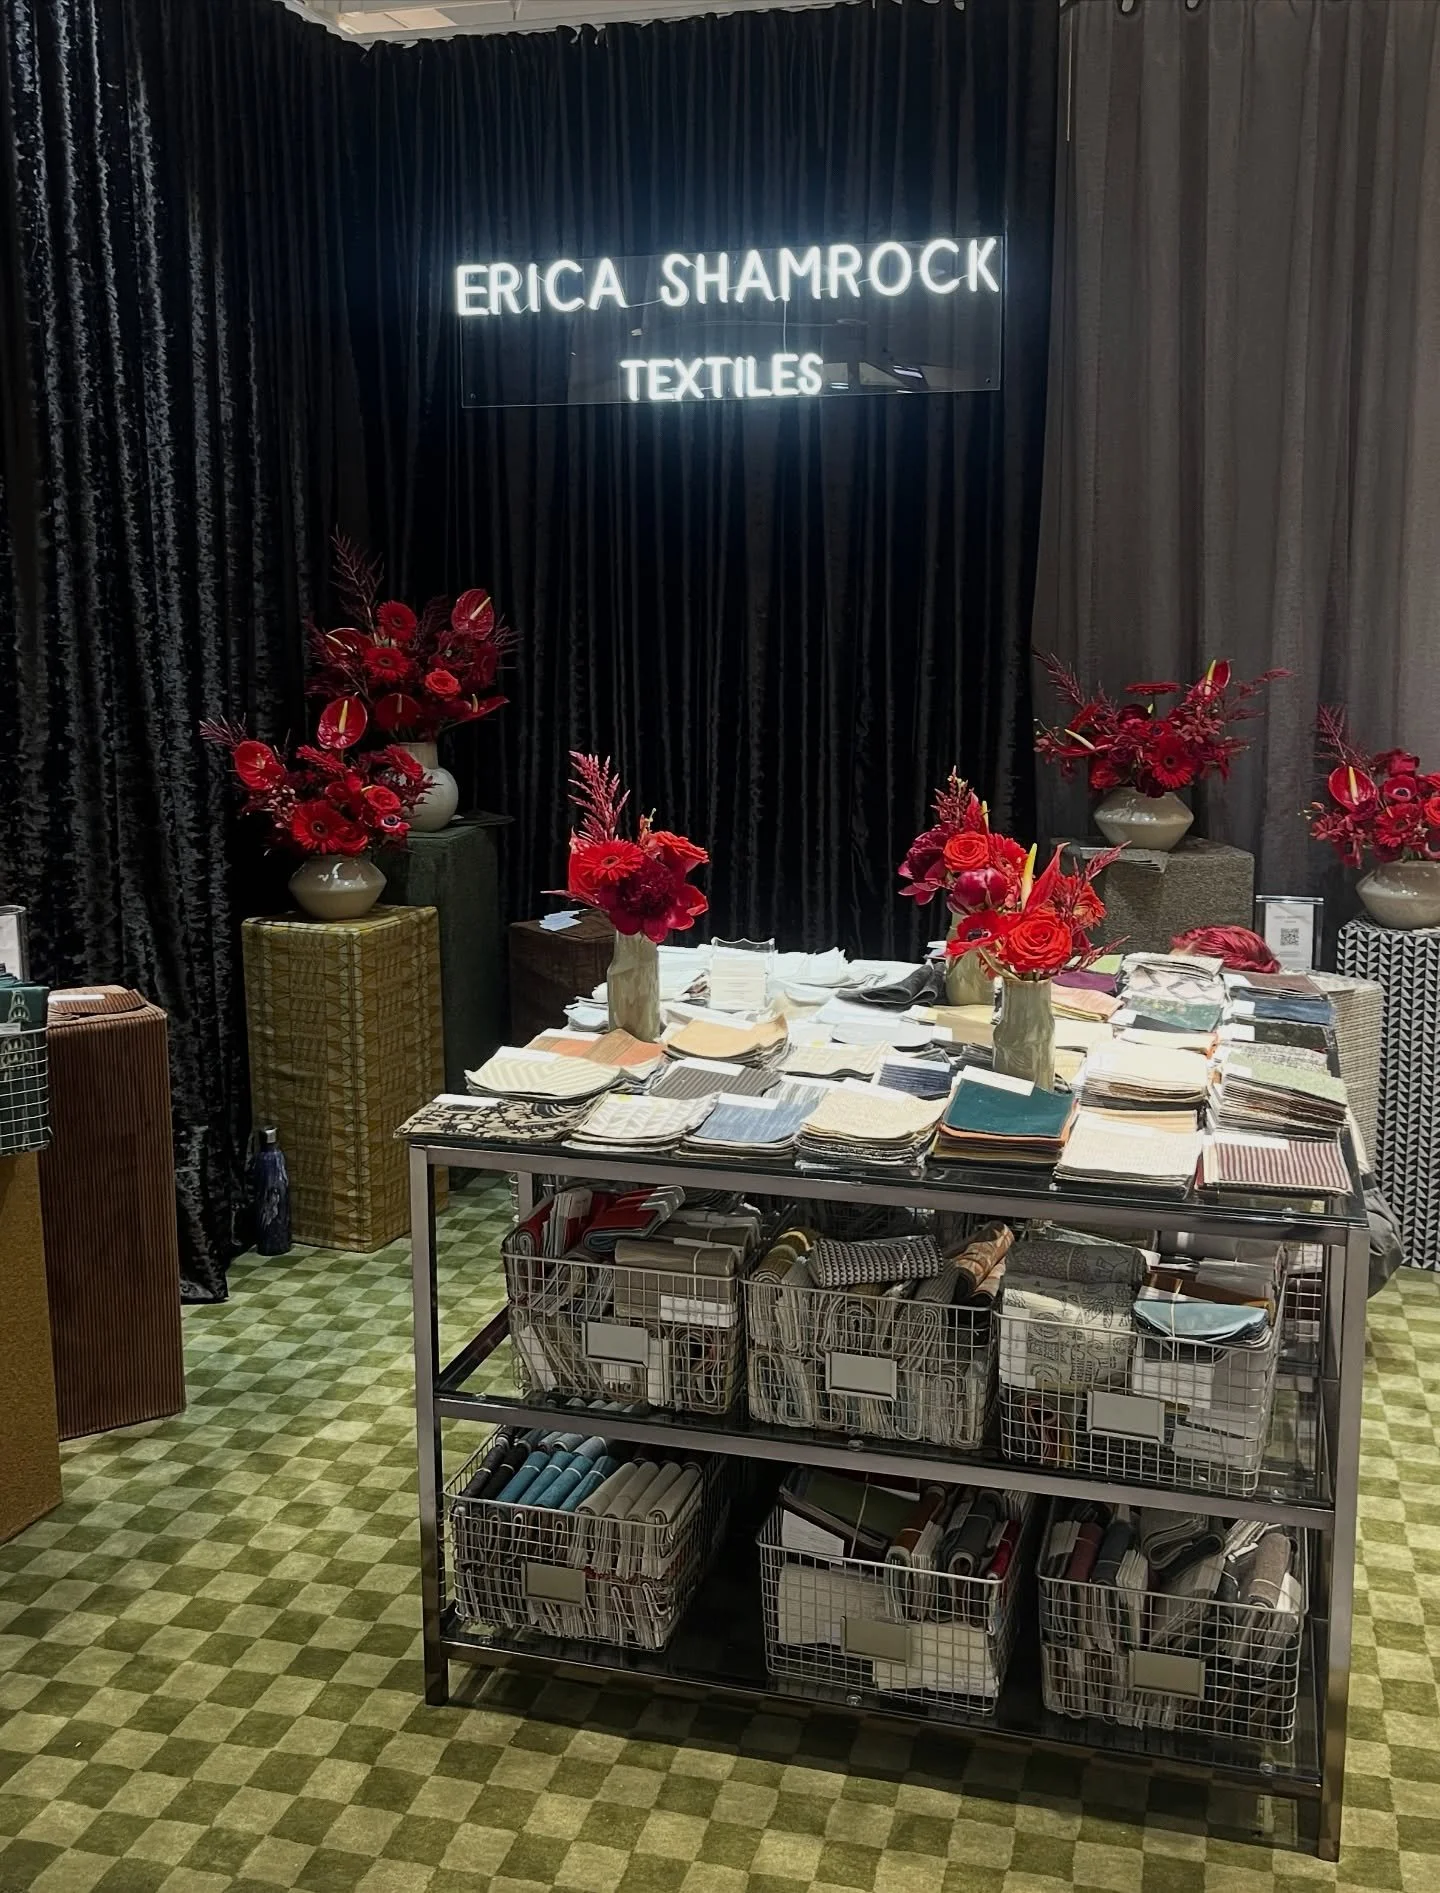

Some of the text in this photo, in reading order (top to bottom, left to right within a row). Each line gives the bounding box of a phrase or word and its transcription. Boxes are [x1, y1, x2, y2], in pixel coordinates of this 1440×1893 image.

[457, 238, 1000, 316] ERICA SHAMROCK
[620, 353, 823, 402] TEXTILES
